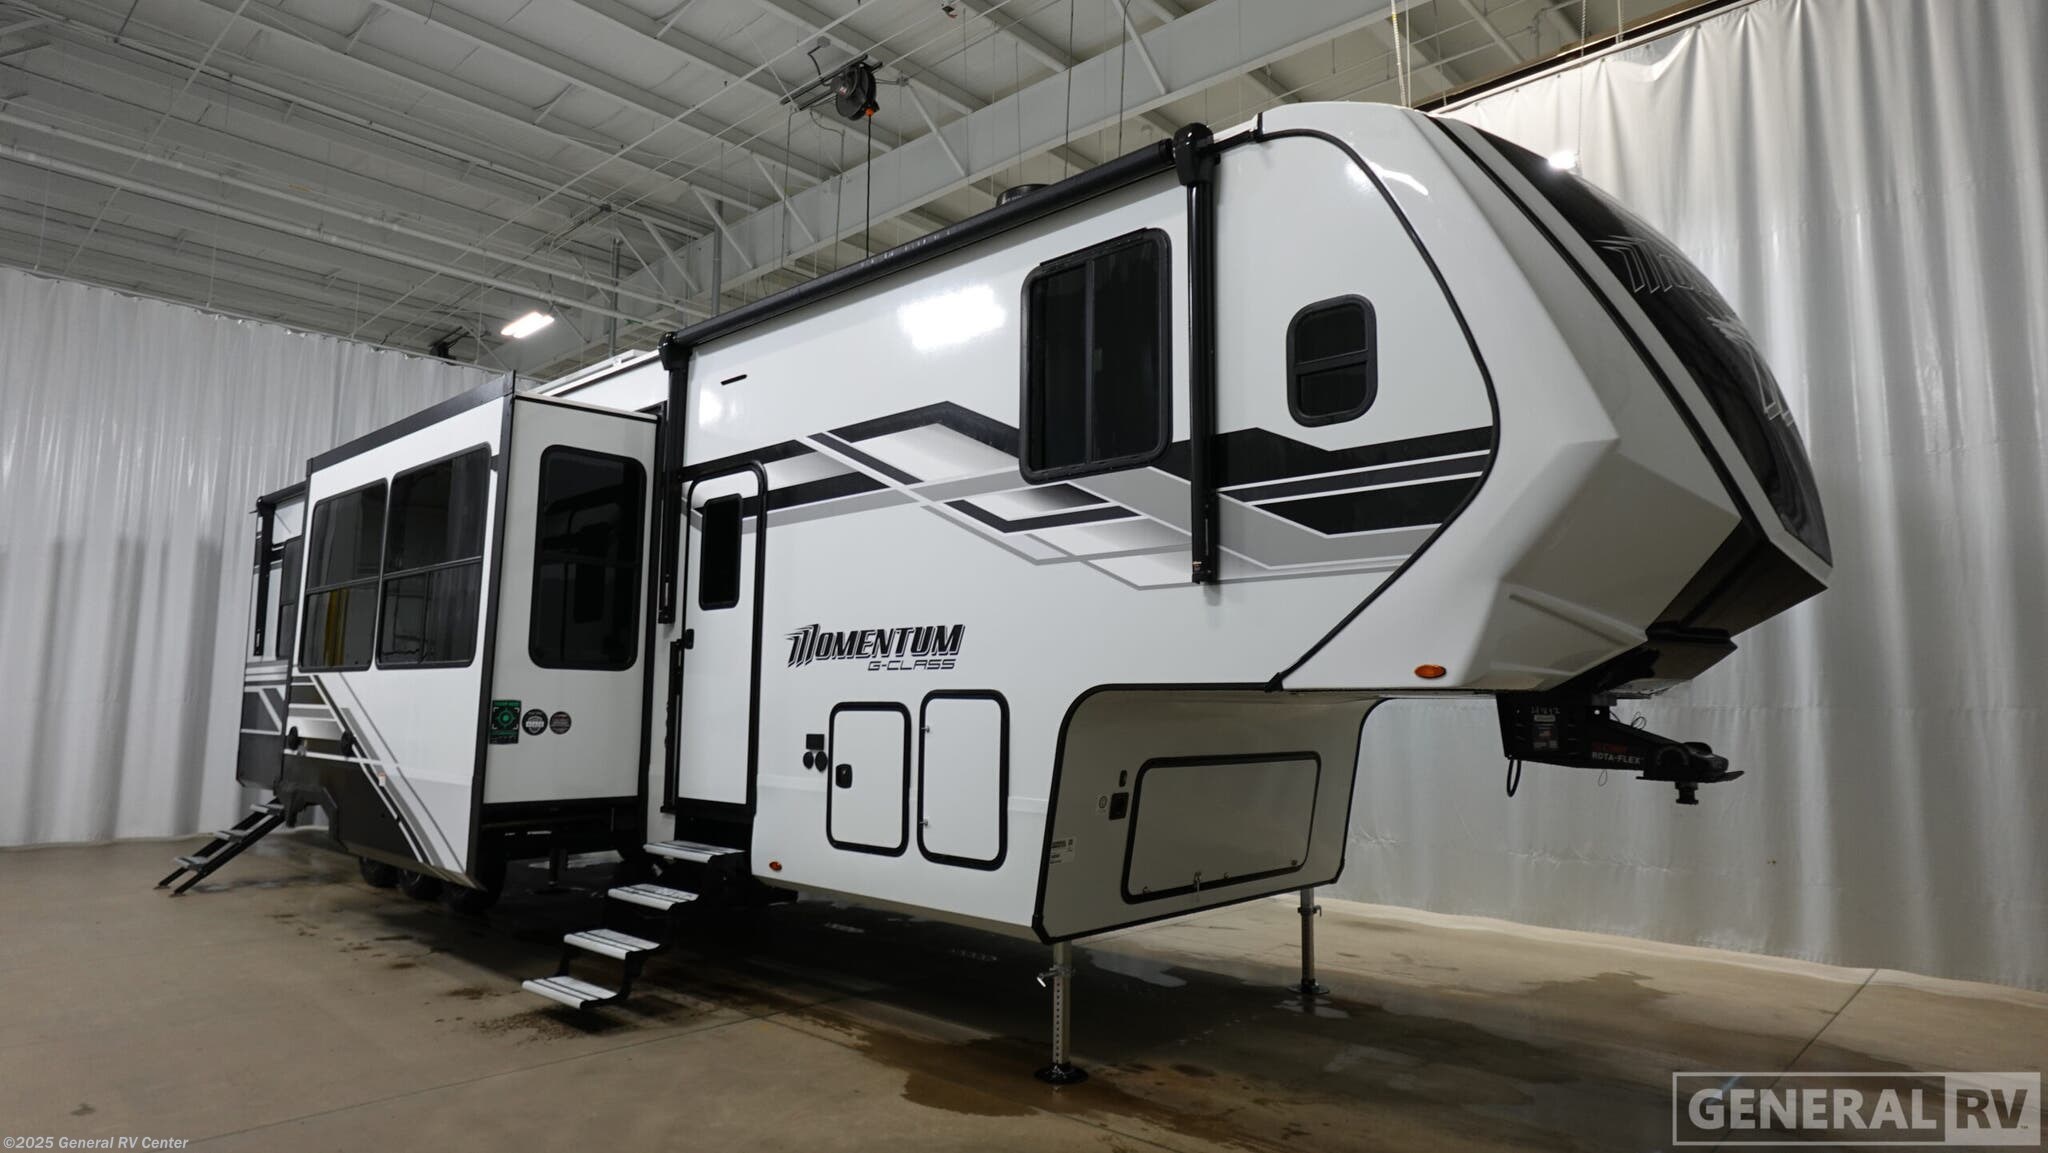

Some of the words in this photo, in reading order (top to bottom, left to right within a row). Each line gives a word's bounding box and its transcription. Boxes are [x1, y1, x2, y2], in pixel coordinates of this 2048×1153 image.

[785, 624, 965, 667] MOMENTUM
[867, 659, 956, 671] G-CLASS
[1592, 752, 1641, 765] ROTA-FLEX
